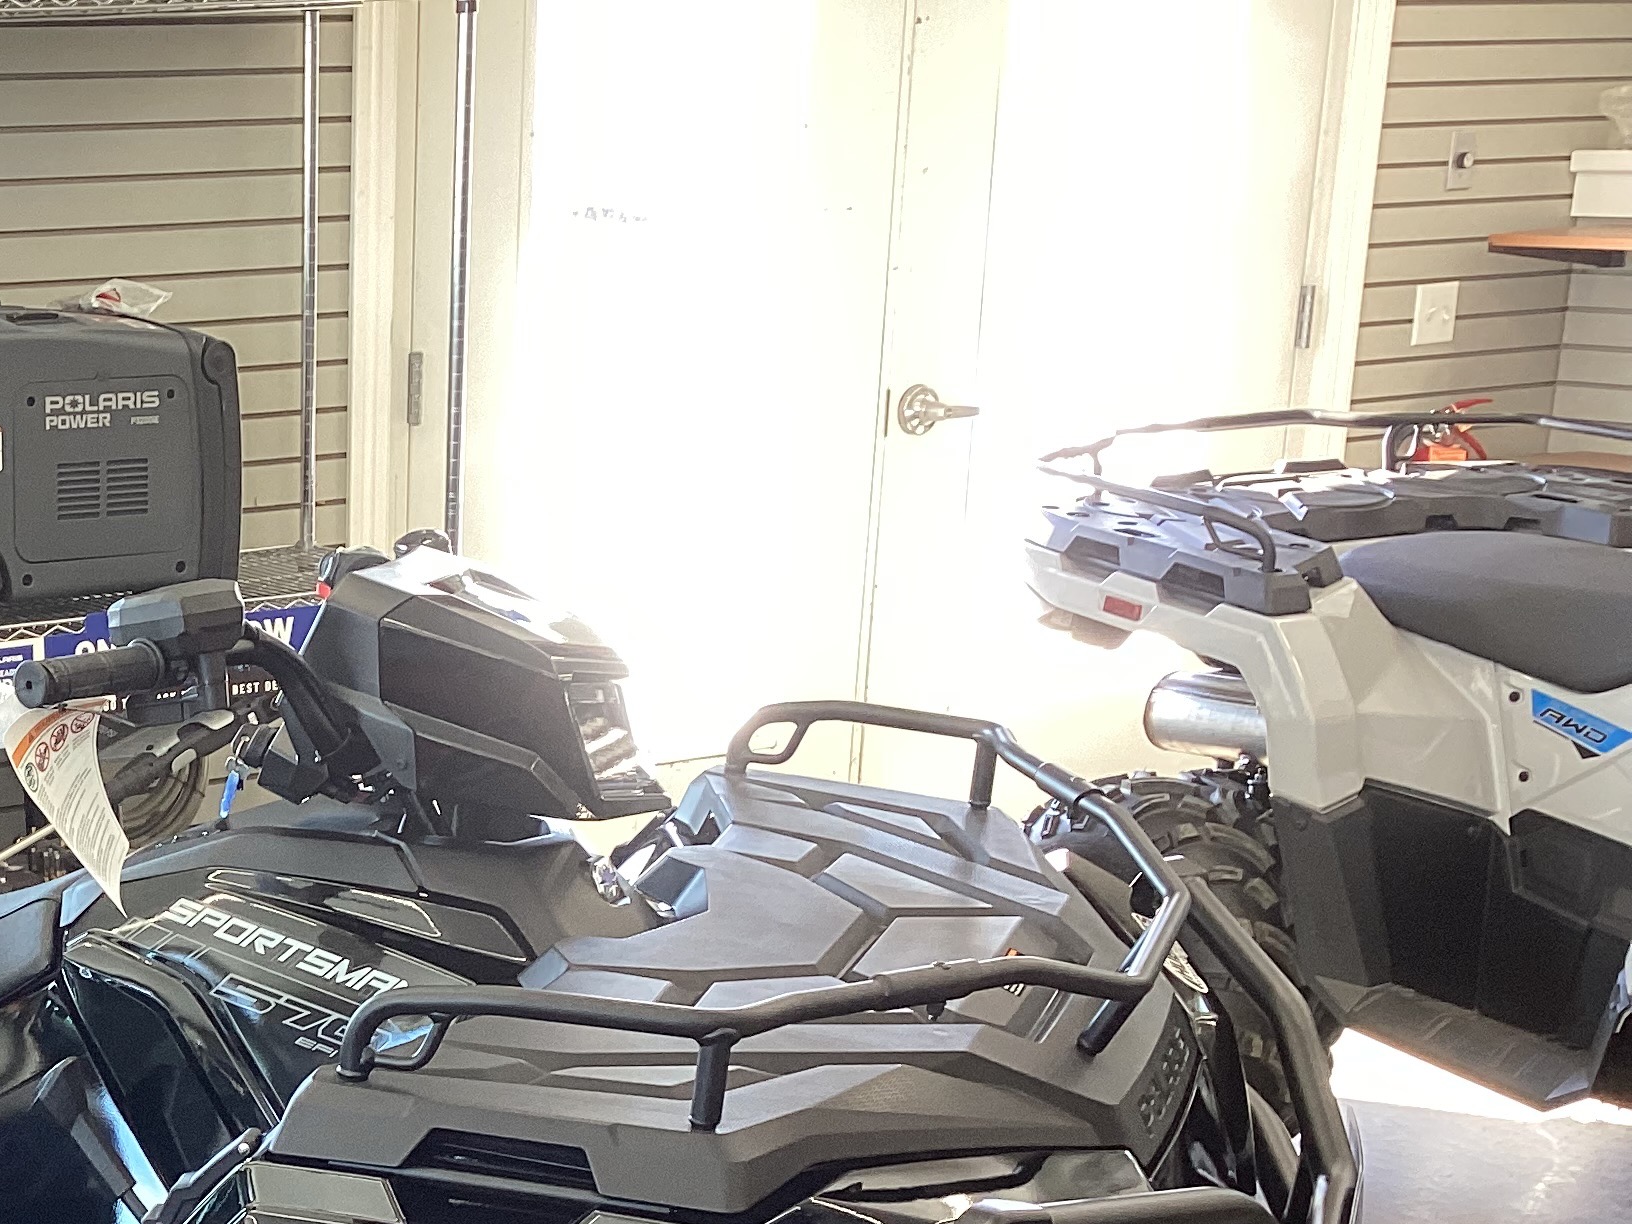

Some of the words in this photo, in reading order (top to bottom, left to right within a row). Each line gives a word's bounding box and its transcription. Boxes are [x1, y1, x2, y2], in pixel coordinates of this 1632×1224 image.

[45, 390, 160, 414] POLARIS
[45, 412, 111, 431] POWER
[231, 681, 260, 696] BEST
[1539, 708, 1608, 744] AWD
[294, 1036, 339, 1058] EFI
